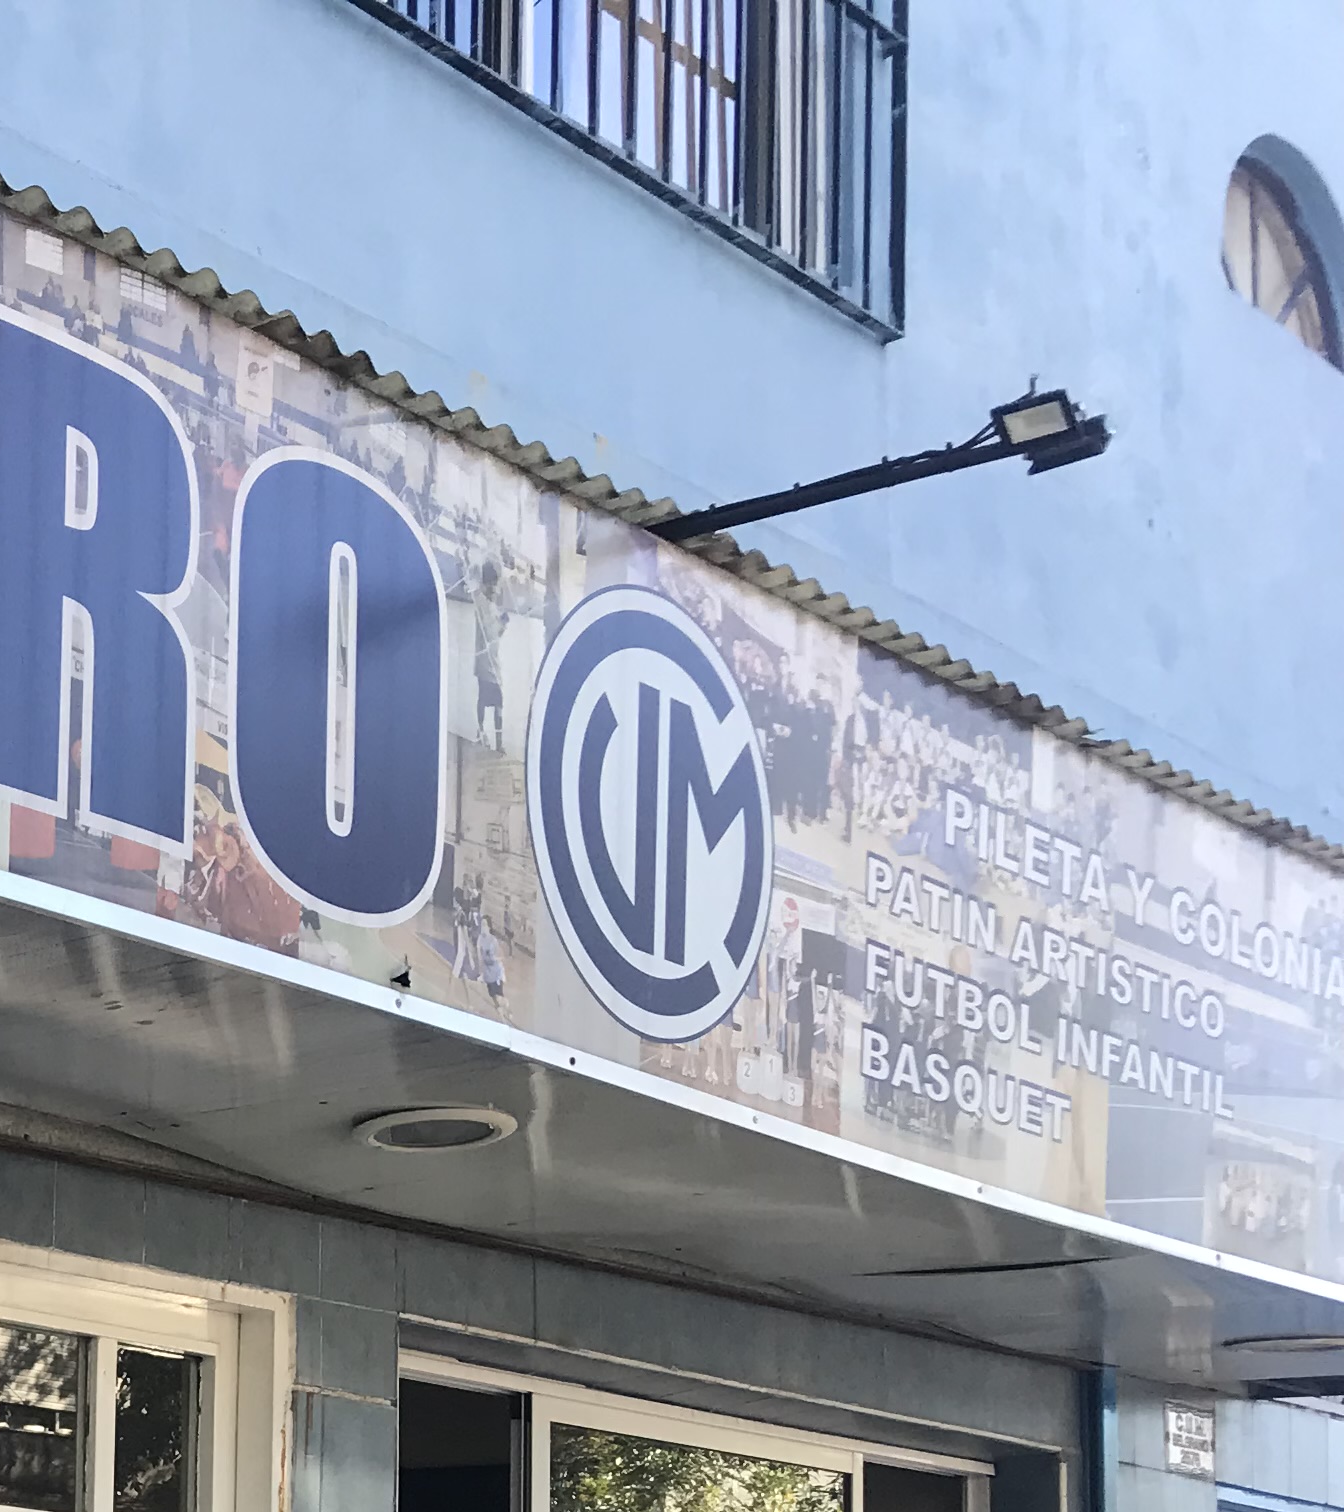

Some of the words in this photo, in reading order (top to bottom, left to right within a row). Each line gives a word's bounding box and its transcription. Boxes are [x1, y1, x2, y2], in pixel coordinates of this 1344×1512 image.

[865, 851, 997, 954] PATIN
[1011, 920, 1226, 1041] ARTISTICO
[944, 789, 1110, 913] PILETA
[1125, 865, 1155, 929] Y
[1169, 891, 1344, 1006] COLONIA
[861, 1030, 1073, 1144] BASQUET
[865, 940, 1044, 1055] FUTBOL
[1056, 1017, 1236, 1122] INFANTIL
